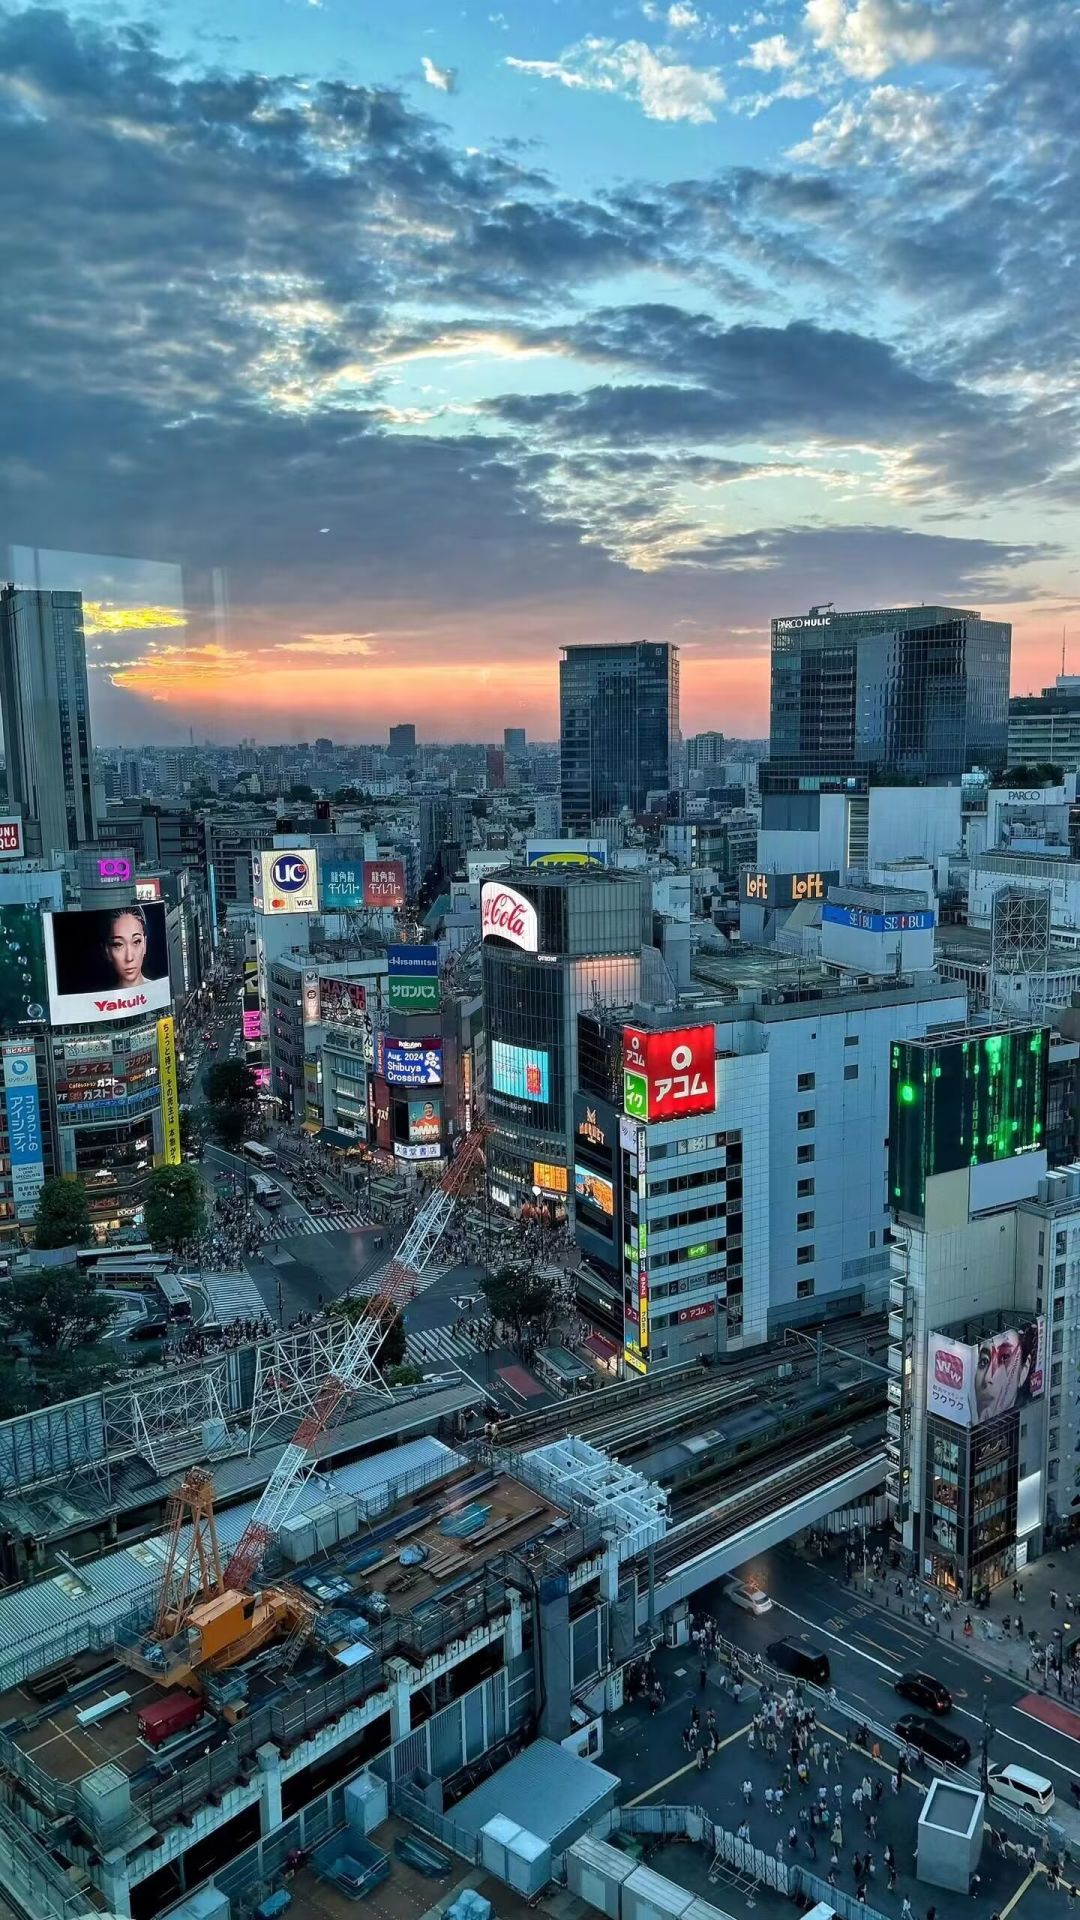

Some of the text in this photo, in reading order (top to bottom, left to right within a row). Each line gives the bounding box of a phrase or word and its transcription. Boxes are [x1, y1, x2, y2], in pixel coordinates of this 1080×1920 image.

[777, 618, 831, 629] PARCO HULIC
[1008, 791, 1041, 801] PARCO
[97, 858, 130, 881] 109
[849, 913, 873, 929] SEIBU
[884, 915, 924, 930] SEIBU
[389, 956, 437, 966] Hisamitsu
[391, 984, 436, 998] サロンパス
[94, 994, 148, 1012] Yakult
[398, 1041, 422, 1049] Rakuten
[387, 1051, 424, 1061] Aug. 2024
[626, 1049, 645, 1067] アコム
[67, 1063, 111, 1075] プライス
[387, 1061, 421, 1073] Shibuya
[97, 1077, 119, 1087] ガスト
[387, 1071, 426, 1083] Crossing
[654, 1072, 708, 1103] アコム
[83, 1088, 111, 1100] ガスト
[10, 1096, 27, 1152] アイシティ
[25, 1095, 38, 1152] コンタクトの
[410, 1124, 439, 1136] DMM
[689, 1307, 706, 1317] アコム
[932, 1390, 964, 1411] ワクワク
